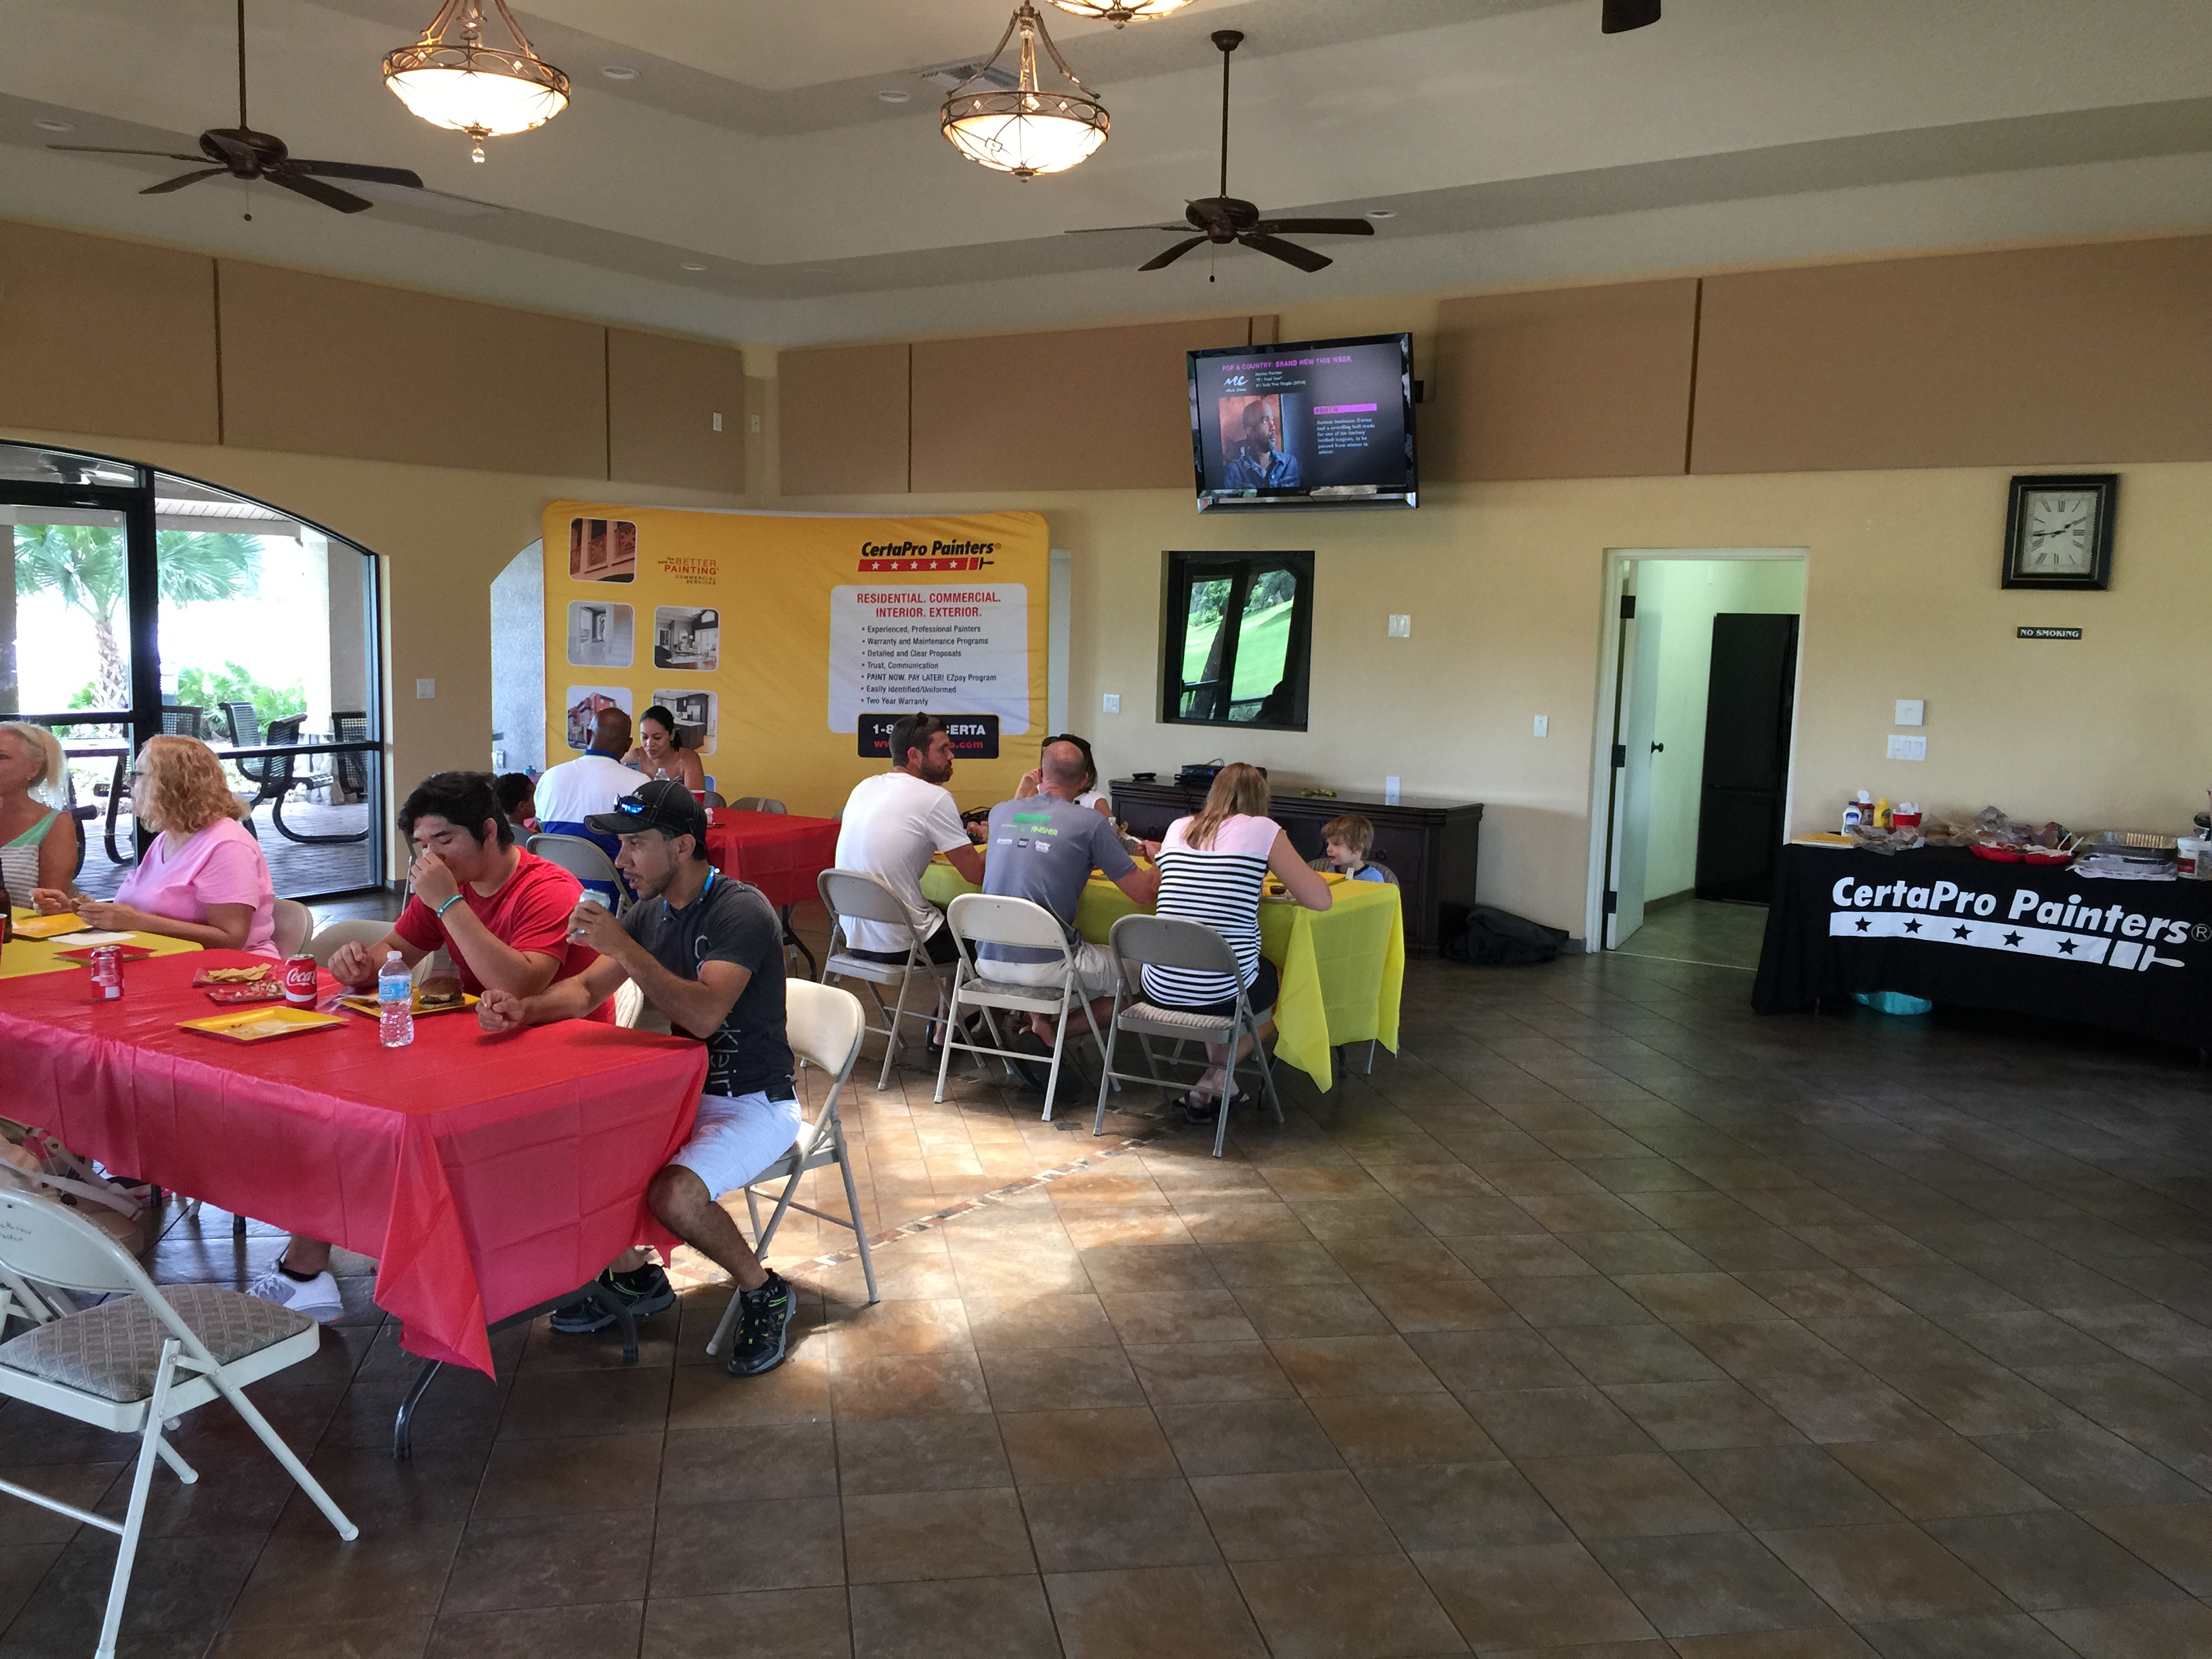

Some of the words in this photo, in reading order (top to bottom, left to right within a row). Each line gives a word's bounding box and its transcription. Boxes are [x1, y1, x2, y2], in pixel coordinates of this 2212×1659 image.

[1275, 359, 1297, 368] BRAND
[862, 541, 927, 556] CertaPro
[676, 557, 716, 567] BETTER
[664, 565, 716, 575] PAINTING
[857, 593, 926, 603] RESIDENTIAL.
[929, 592, 1001, 603] COMMERCIAL.
[876, 608, 926, 617] INTERIOR.
[929, 607, 982, 617] EXTERIOR.
[867, 626, 909, 634] Experienced,
[867, 638, 897, 646] Warranty
[957, 638, 988, 646] Programs
[929, 650, 961, 658] Proposals
[867, 662, 886, 670] Trust,
[946, 674, 966, 683] EZpay
[968, 674, 996, 682] Program
[866, 685, 886, 694] Easily
[1832, 877, 1996, 916] CertaPro
